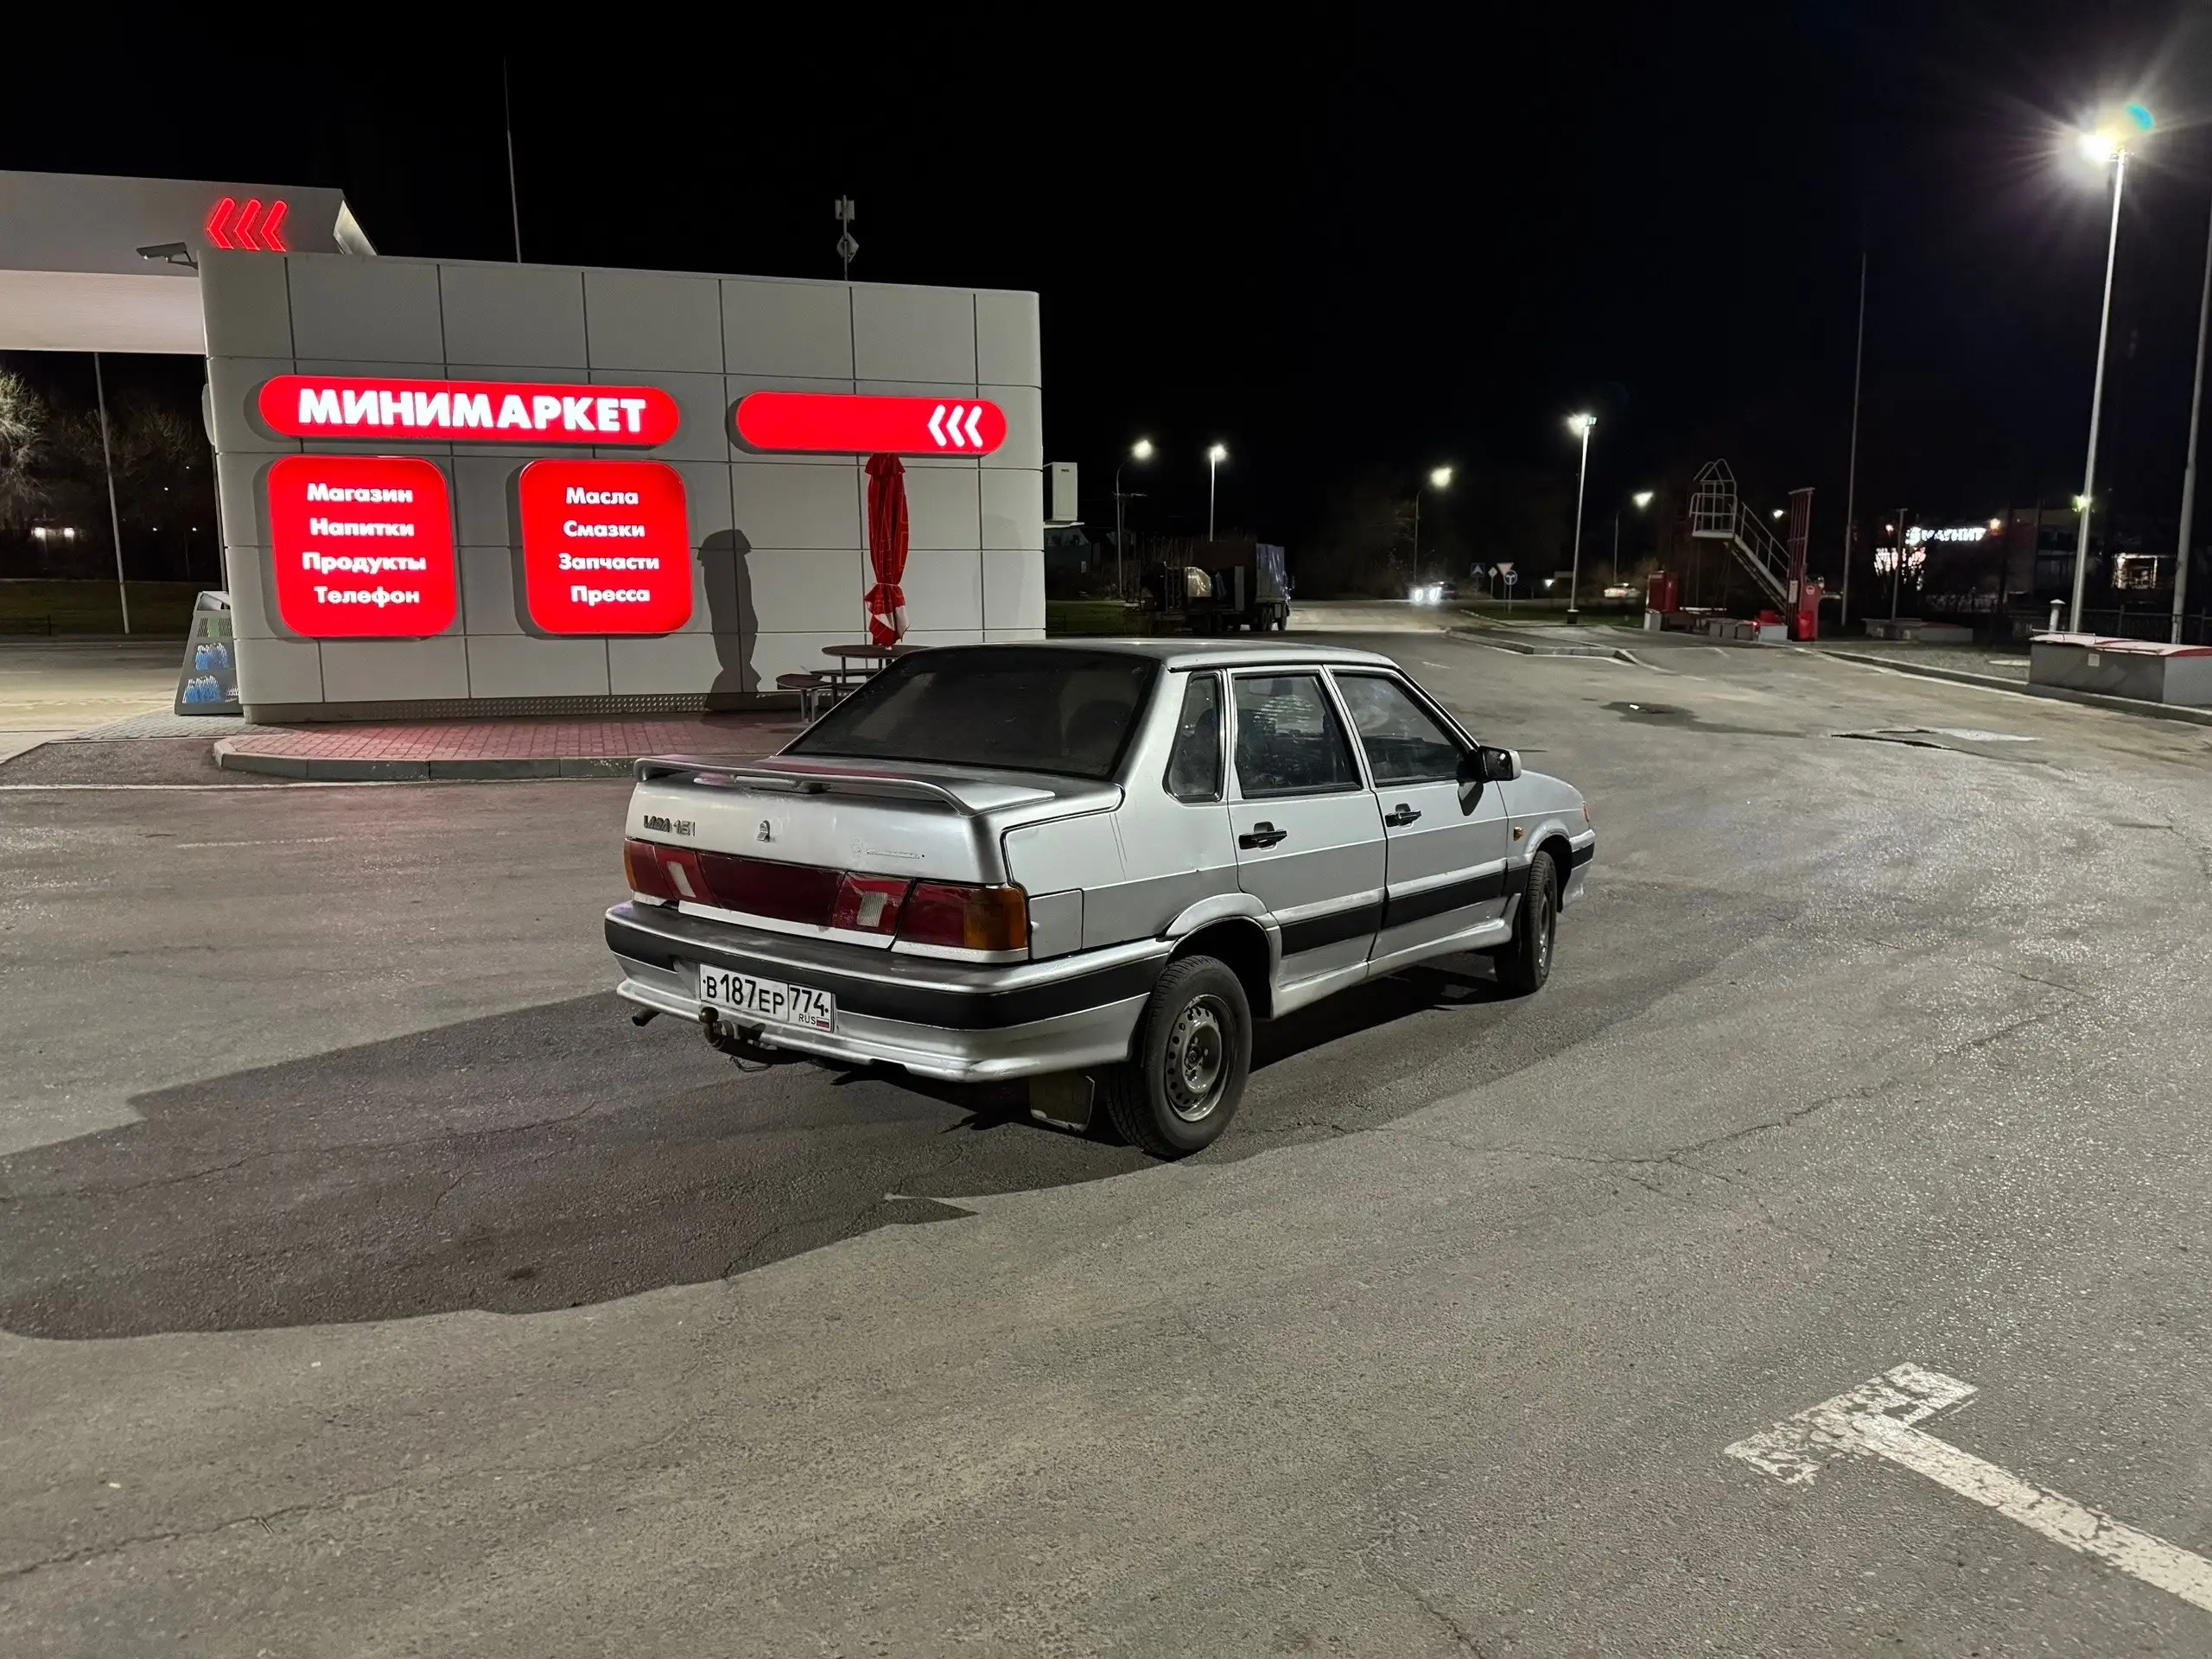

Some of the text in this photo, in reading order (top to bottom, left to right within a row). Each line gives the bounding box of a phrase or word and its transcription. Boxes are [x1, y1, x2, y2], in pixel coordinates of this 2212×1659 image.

[299, 388, 646, 433] МИНИМАРКЕТ
[307, 483, 413, 504] Магазин
[566, 486, 639, 505] Масла
[309, 518, 415, 537] Напитки
[563, 519, 645, 538] Смазки
[302, 551, 427, 575] Продукты
[558, 552, 660, 570] Запчасти
[314, 586, 420, 608] Телефон
[570, 585, 651, 607] Пресса
[790, 987, 824, 1017] 774
[798, 1013, 816, 1025] RUS
